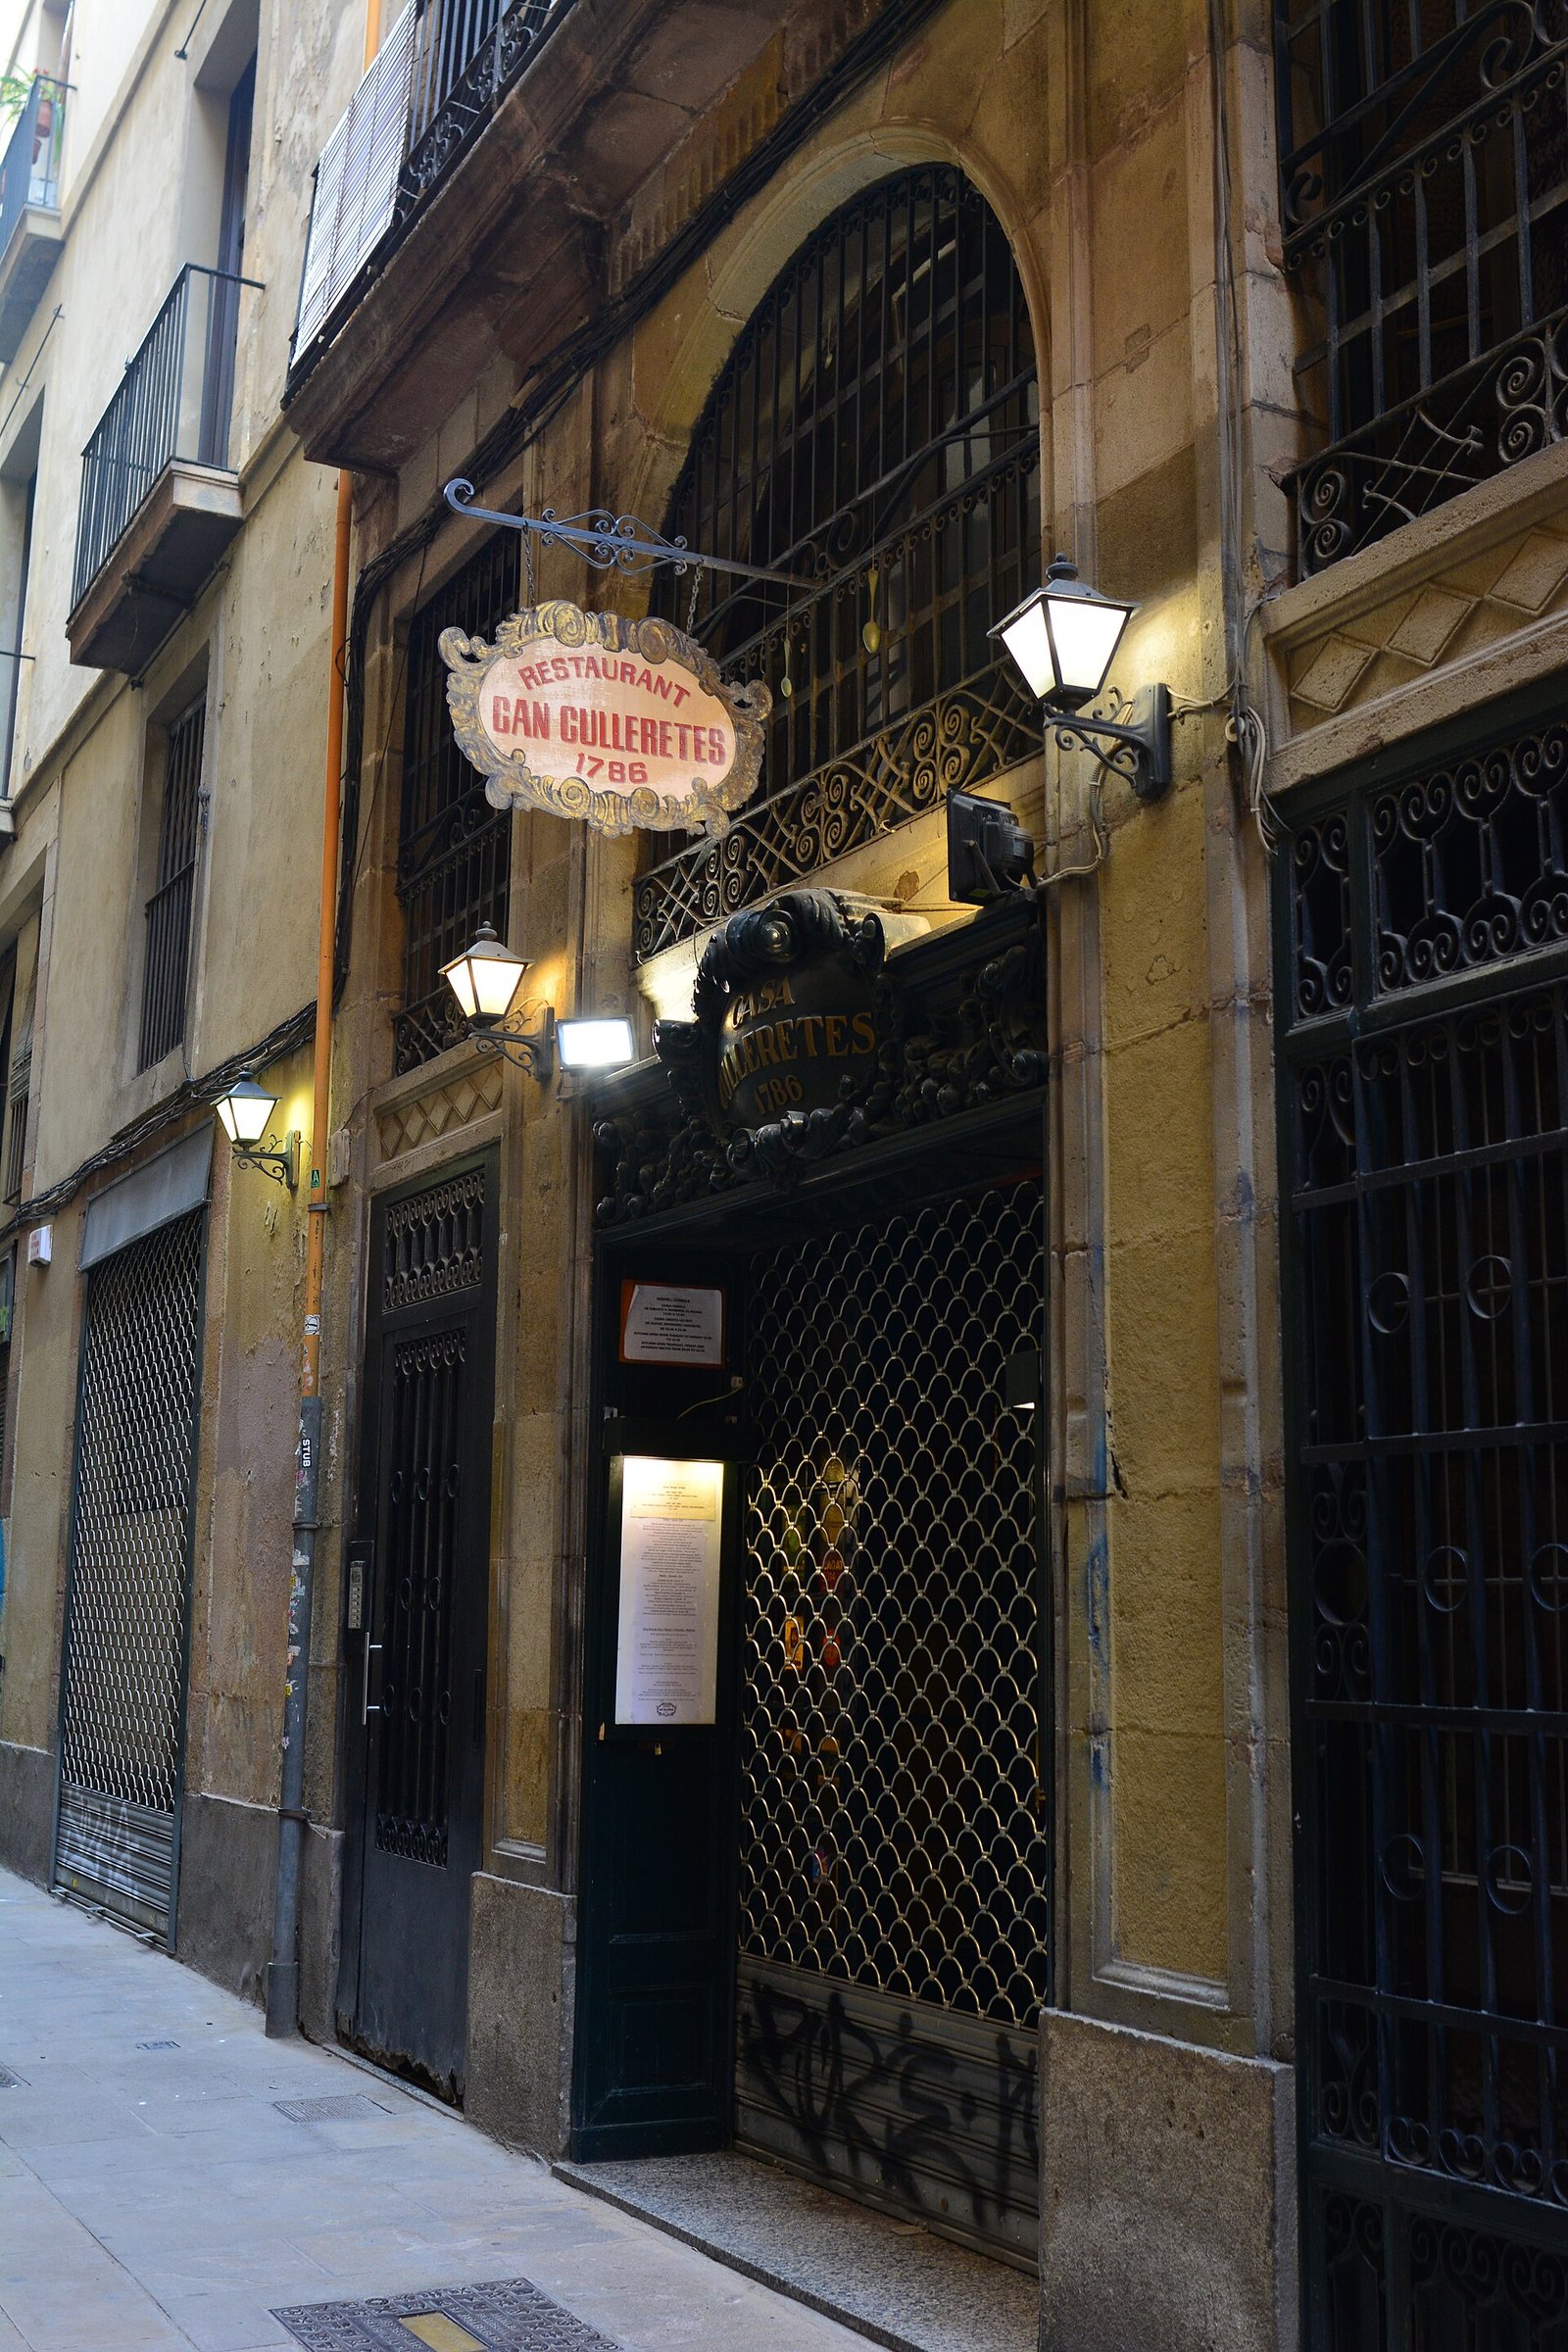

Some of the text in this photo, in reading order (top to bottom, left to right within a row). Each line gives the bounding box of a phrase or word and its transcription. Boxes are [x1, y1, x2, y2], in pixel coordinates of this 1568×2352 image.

[518, 656, 690, 708] RESTAURANT
[492, 696, 727, 766] CAN CULLERETES
[575, 753, 648, 783] 1786
[731, 974, 796, 1030] CASA
[754, 1074, 804, 1115] 1786
[302, 1439, 311, 1467] STUB
